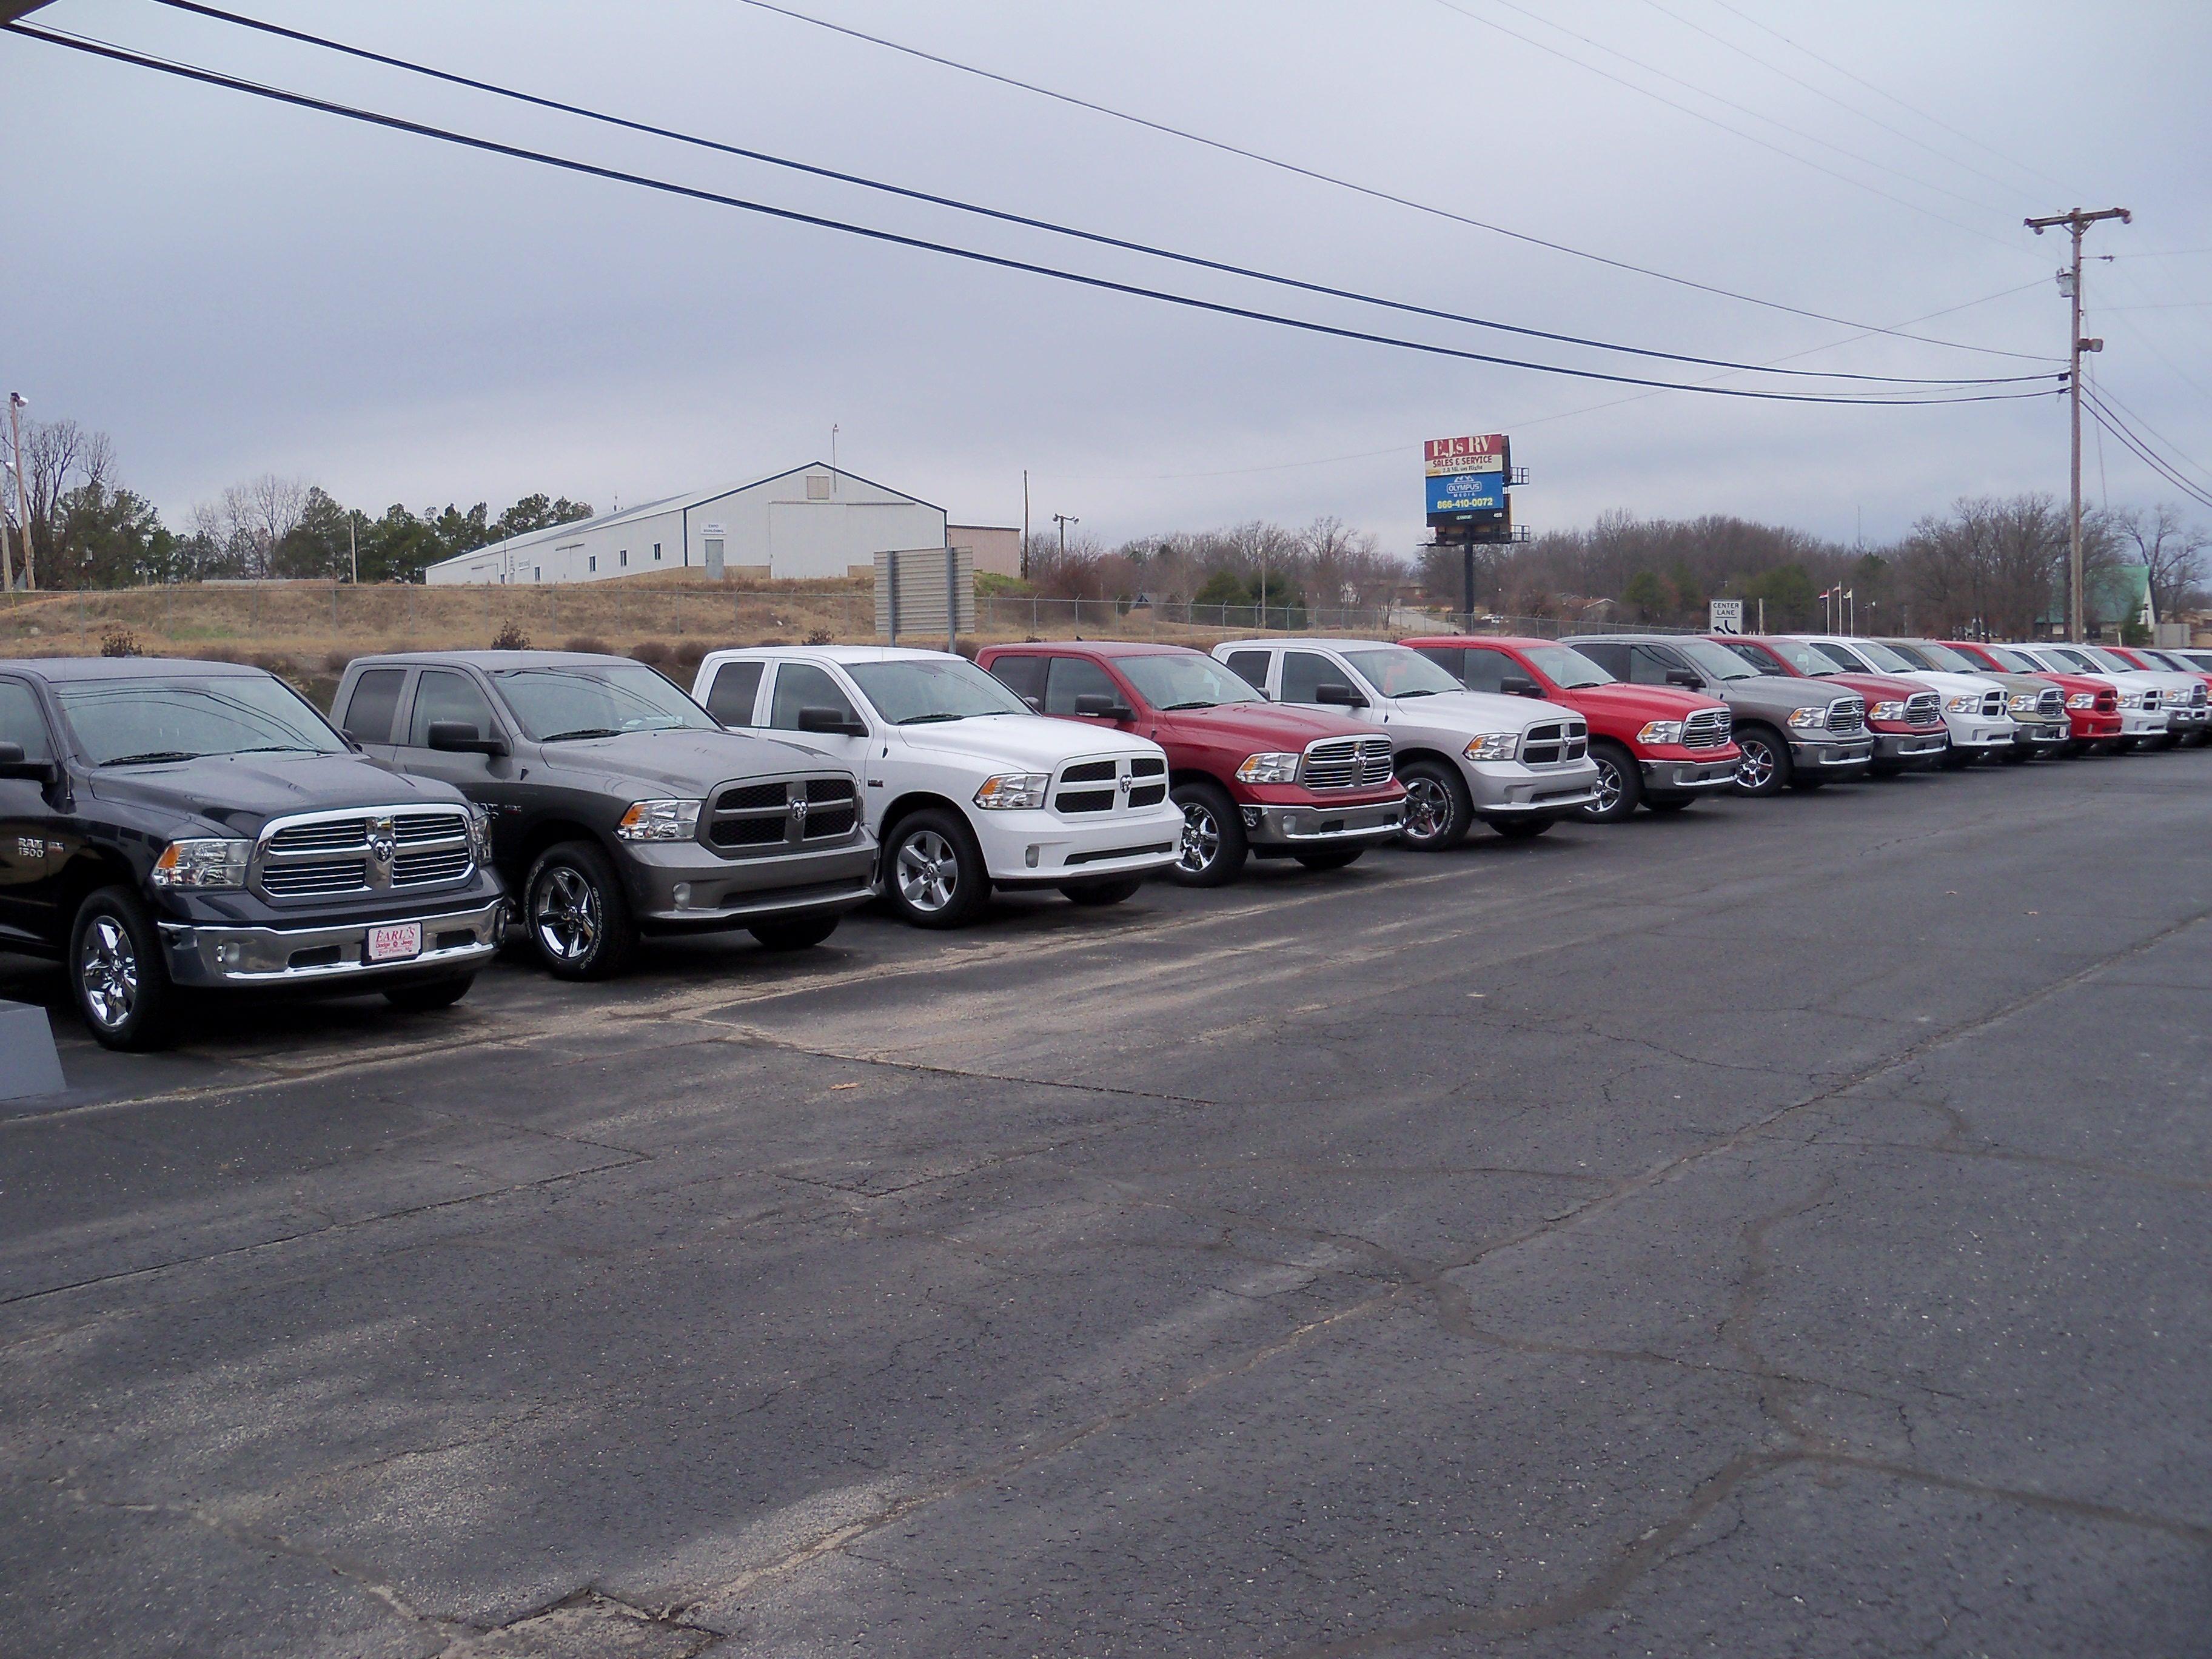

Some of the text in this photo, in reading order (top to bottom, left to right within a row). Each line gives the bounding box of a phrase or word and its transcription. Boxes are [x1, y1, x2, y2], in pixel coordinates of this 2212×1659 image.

[1468, 436, 1492, 454] RV
[1433, 458, 1453, 468] SALES
[1462, 455, 1492, 465] SERVICE
[1449, 483, 1480, 492] OLYMPUS
[1436, 497, 1493, 509] 866-410-0072
[18, 848, 44, 857] 1500
[376, 927, 415, 942] EARL'S
